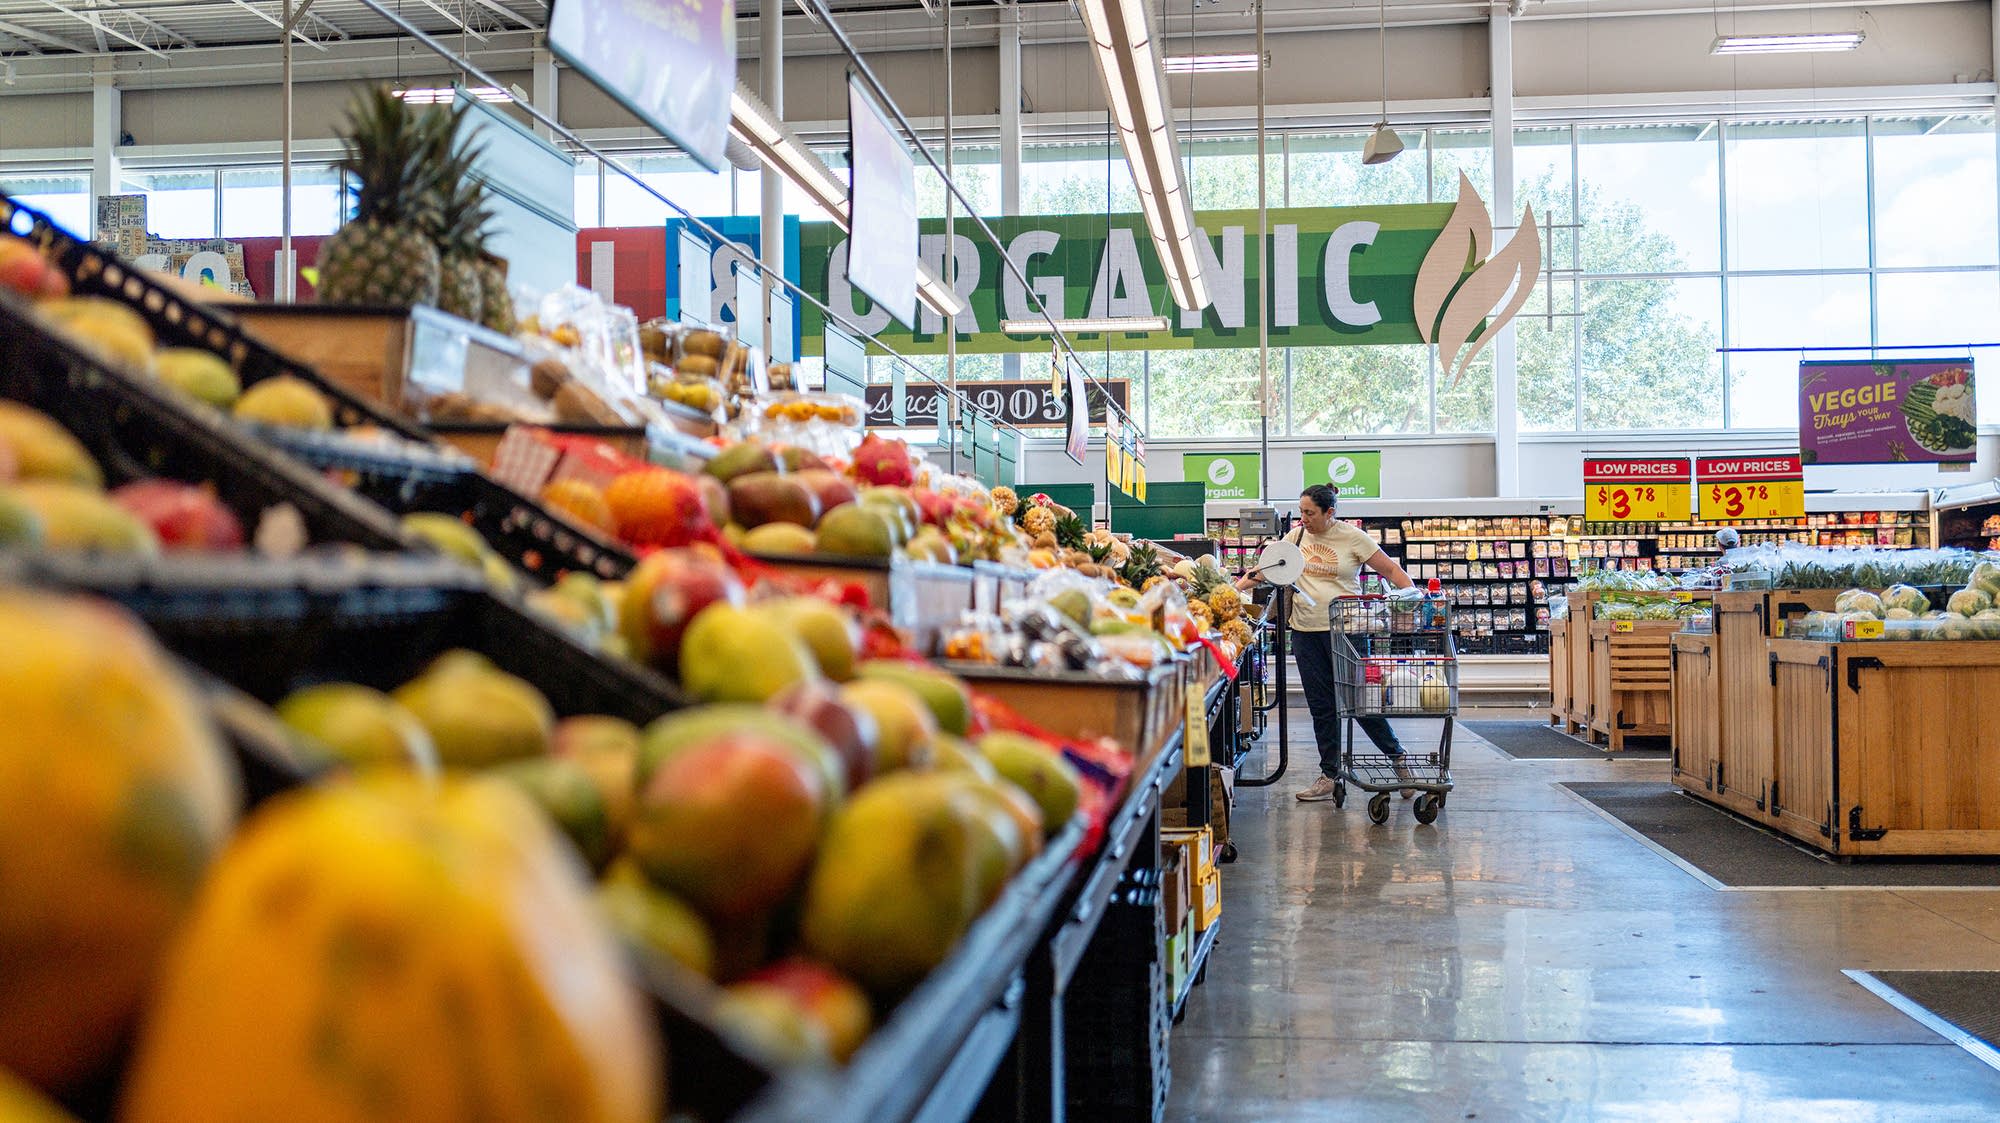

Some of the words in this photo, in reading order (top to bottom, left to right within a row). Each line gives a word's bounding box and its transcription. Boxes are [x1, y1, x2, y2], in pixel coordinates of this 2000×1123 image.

[828, 221, 1383, 338] ORGANIC
[868, 390, 939, 416] snce
[956, 389, 1067, 421] 1905
[1809, 381, 1896, 413] VEGGIE
[1813, 413, 1857, 430] Trays
[1857, 407, 1879, 417] YOUR
[1874, 411, 1891, 422] WAY
[1595, 464, 1627, 474] LOW
[1630, 463, 1677, 474] PRICES
[1708, 462, 1740, 474] LOW
[1743, 460, 1790, 472] PRICES
